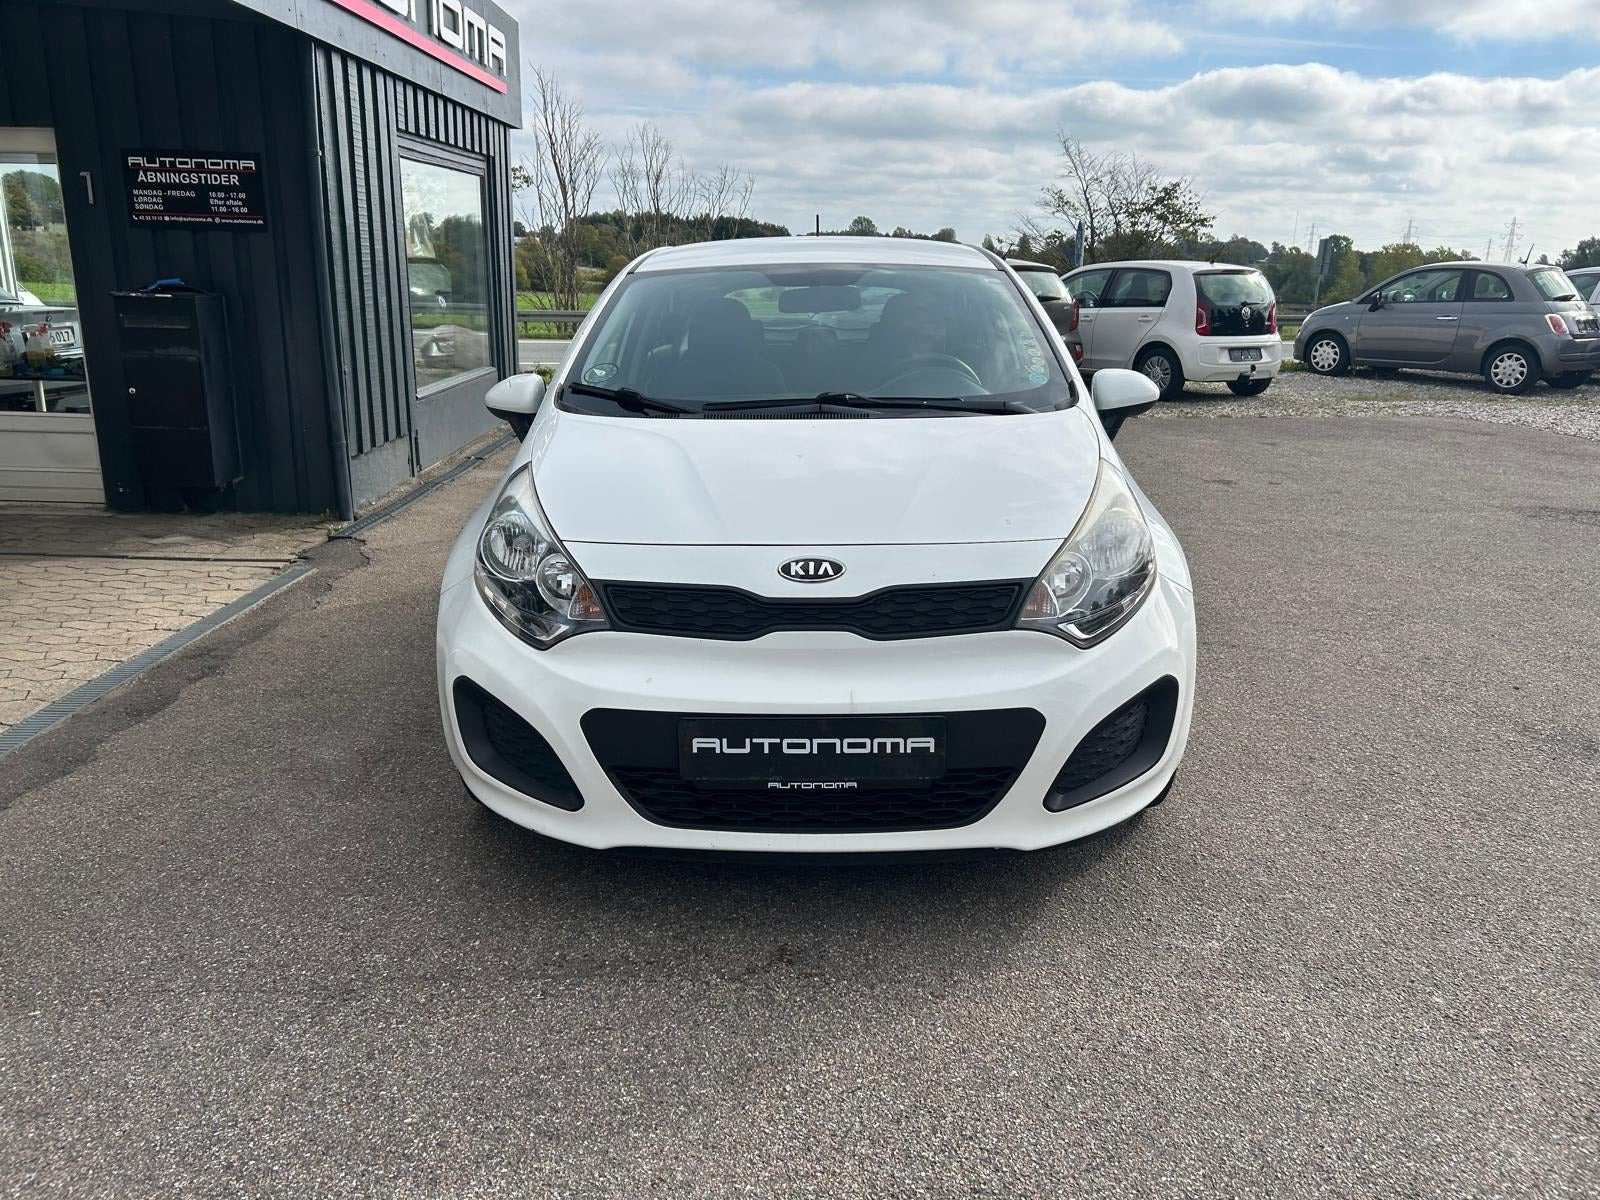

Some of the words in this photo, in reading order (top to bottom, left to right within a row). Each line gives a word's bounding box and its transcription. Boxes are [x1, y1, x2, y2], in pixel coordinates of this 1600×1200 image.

[128, 156, 256, 171] AUTONOMA
[137, 170, 240, 186] ÅBNINGSTIDER
[135, 203, 164, 211] SØNDAG
[210, 198, 225, 206] Efter
[790, 561, 835, 576] KIA
[692, 737, 935, 754] AUTONOMA
[767, 781, 858, 789] AUTONOMA
